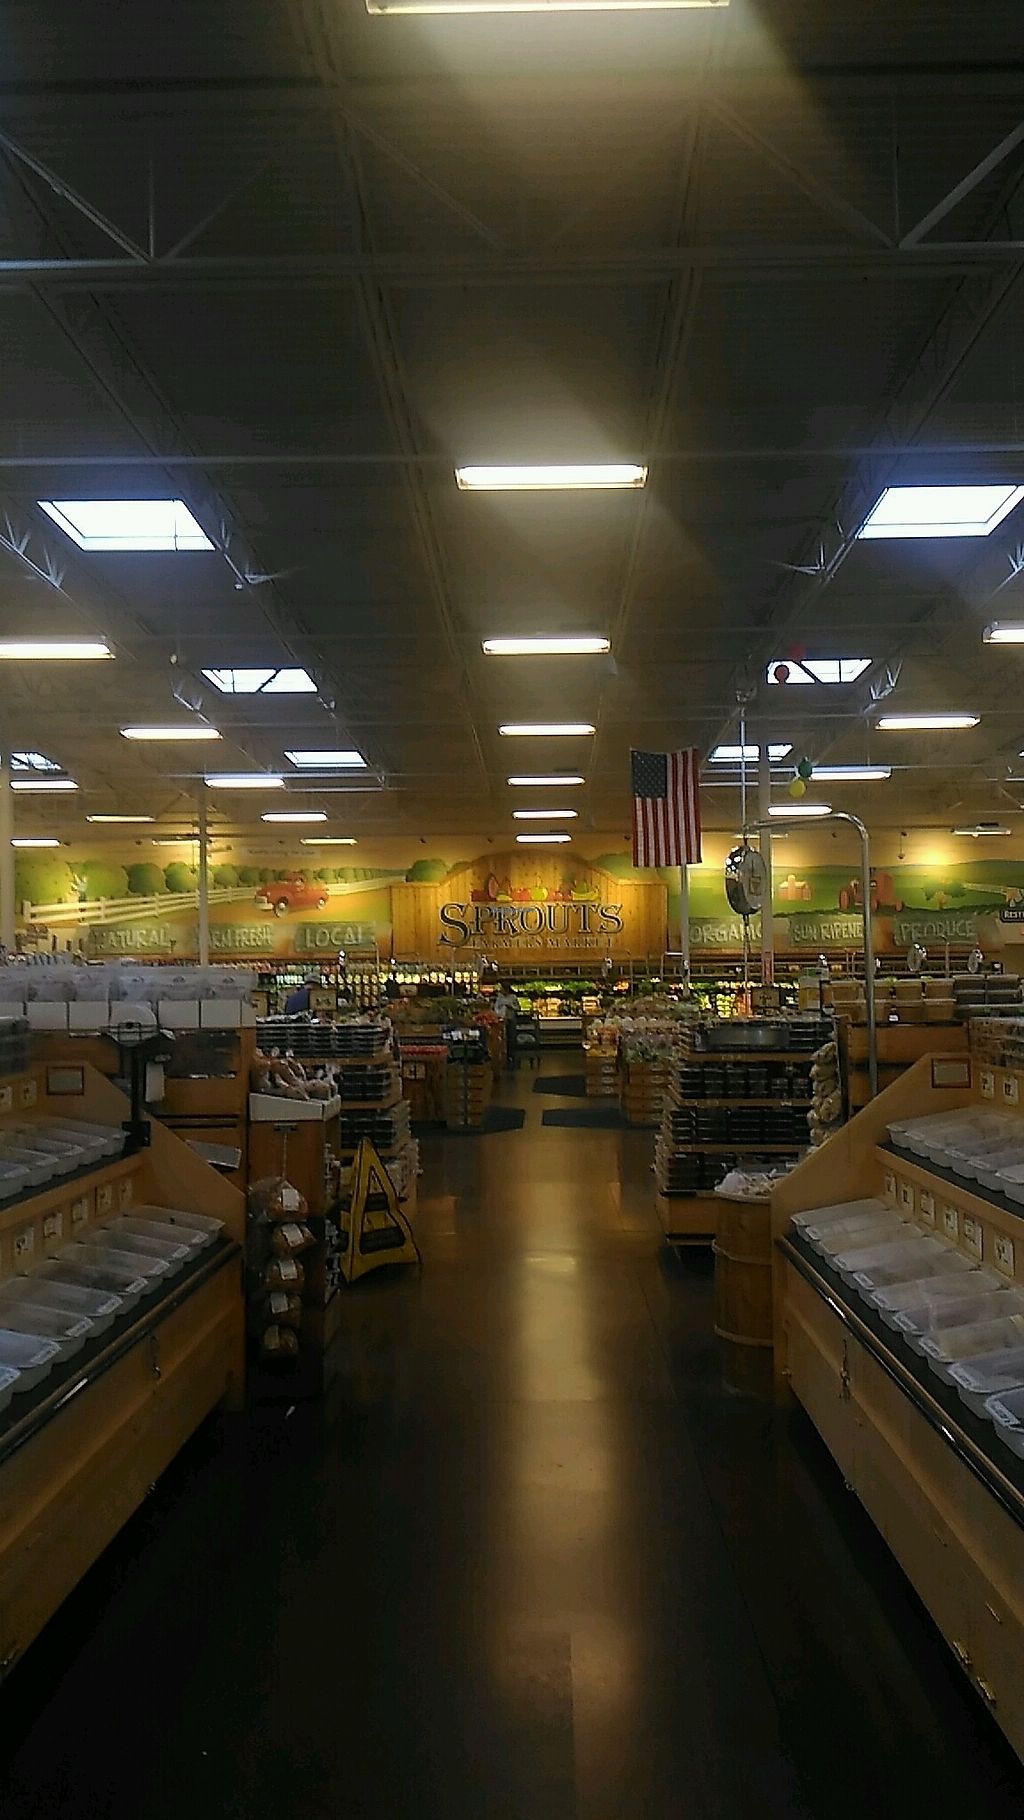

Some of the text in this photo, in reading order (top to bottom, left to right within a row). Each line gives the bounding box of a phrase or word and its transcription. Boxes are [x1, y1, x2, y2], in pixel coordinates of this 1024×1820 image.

[437, 902, 624, 947] SPROUTS
[793, 922, 864, 942] SUN RIPENE
[899, 920, 976, 942] PRODUCE
[235, 926, 272, 947] FRESH
[305, 925, 364, 948] LOCAL
